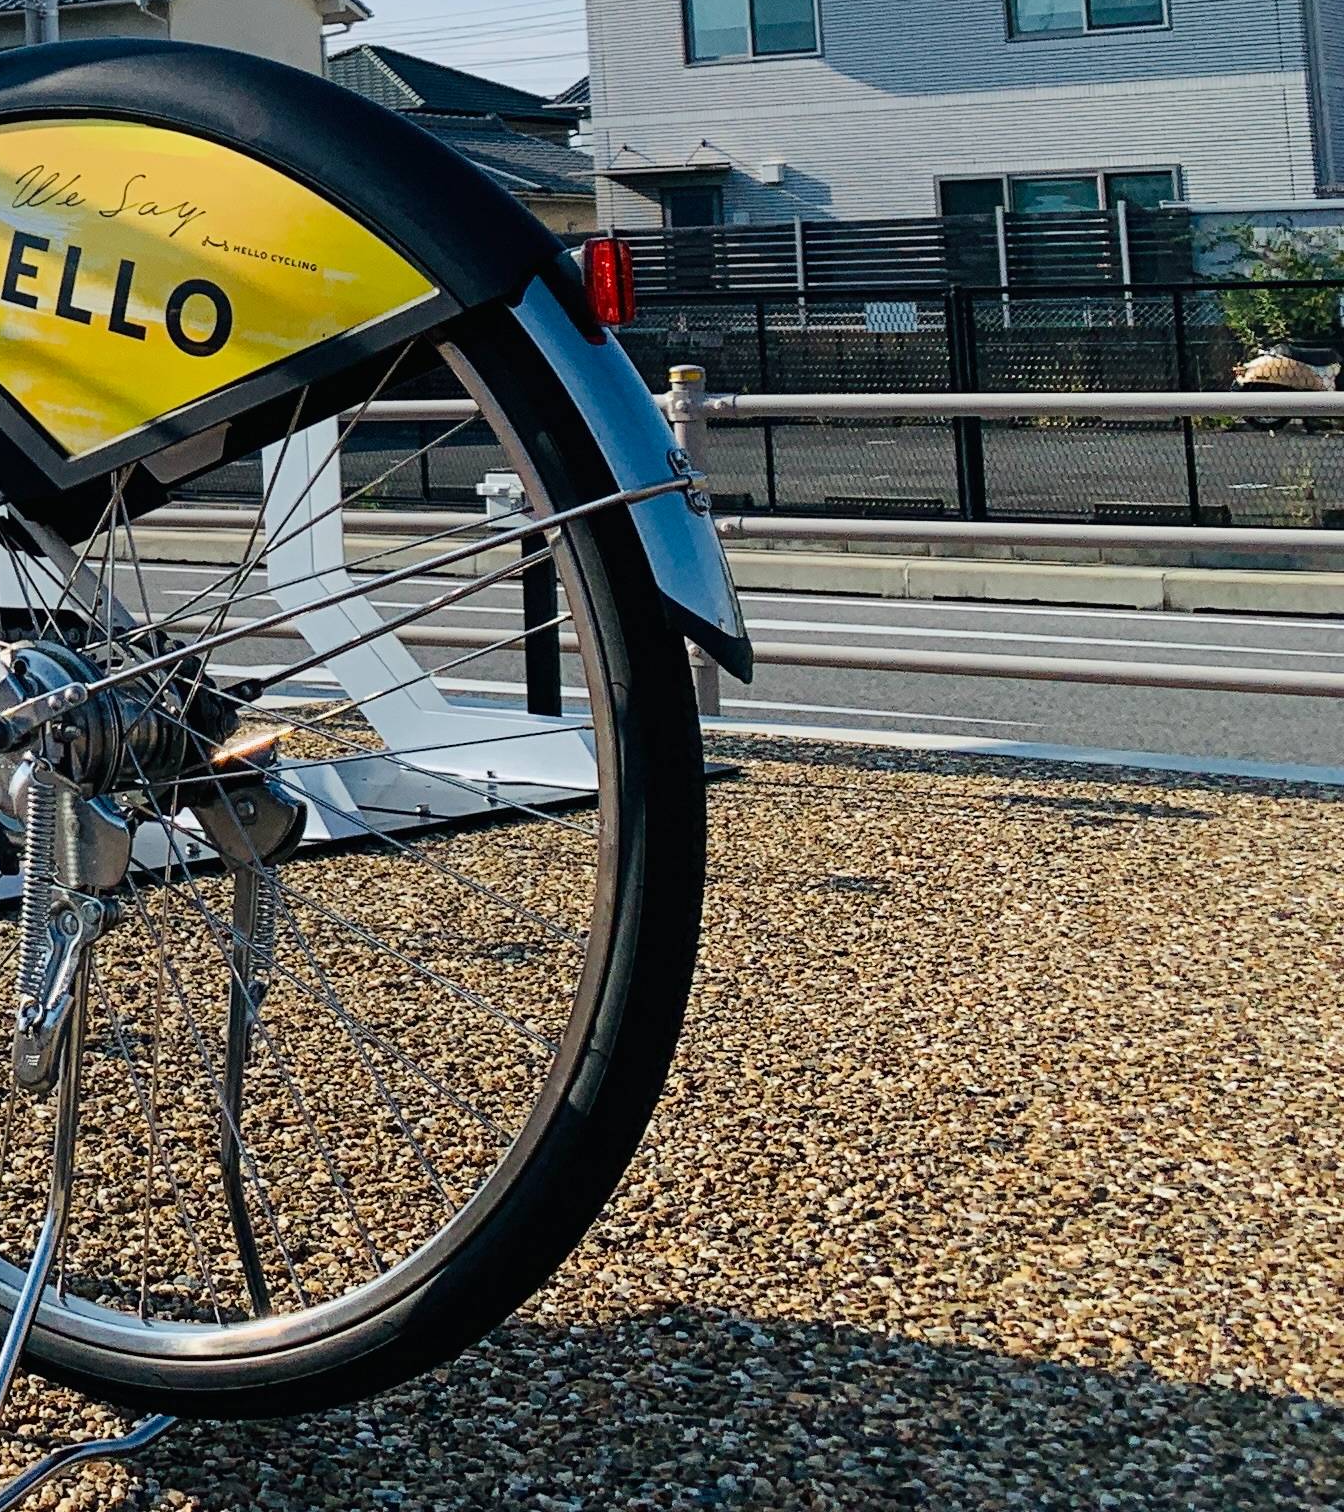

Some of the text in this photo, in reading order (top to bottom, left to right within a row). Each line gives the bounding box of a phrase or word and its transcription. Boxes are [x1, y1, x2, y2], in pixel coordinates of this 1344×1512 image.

[11, 164, 87, 209] We
[98, 173, 207, 238] Say
[233, 245, 318, 272] HELLO CYCLING
